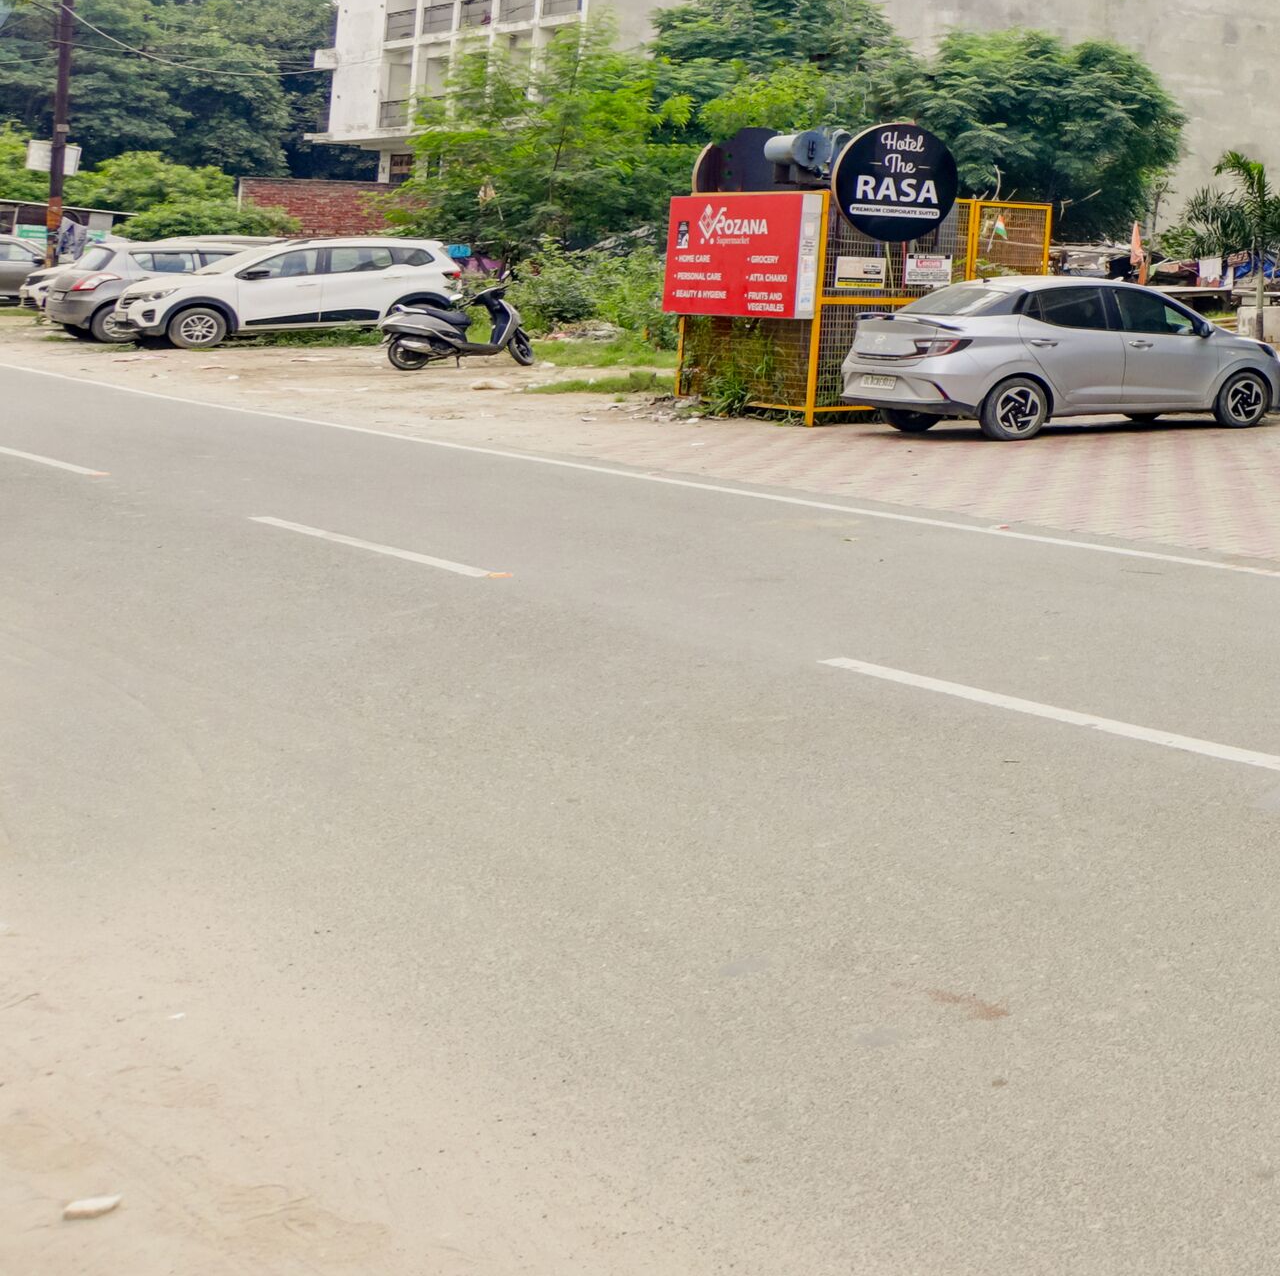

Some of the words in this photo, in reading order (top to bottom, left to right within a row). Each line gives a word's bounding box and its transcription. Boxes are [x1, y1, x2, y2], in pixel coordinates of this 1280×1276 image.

[881, 132, 924, 152] Hotel
[885, 154, 916, 173] The
[856, 175, 938, 204] RASA
[882, 208, 917, 216] CORPORATE
[715, 215, 768, 235] ROZANA
[716, 237, 750, 246] Supermarket
[678, 255, 694, 263] HOME
[695, 255, 711, 263] CARE
[750, 255, 779, 264] GROCERY
[706, 273, 722, 281] CARE
[749, 274, 764, 282] ATTA
[765, 274, 787, 282] CHAKKI
[676, 290, 696, 298] BEAUTY
[703, 291, 726, 299] HYGIENE
[748, 292, 768, 300] FRUITS
[747, 303, 784, 312] VEGETABLES
